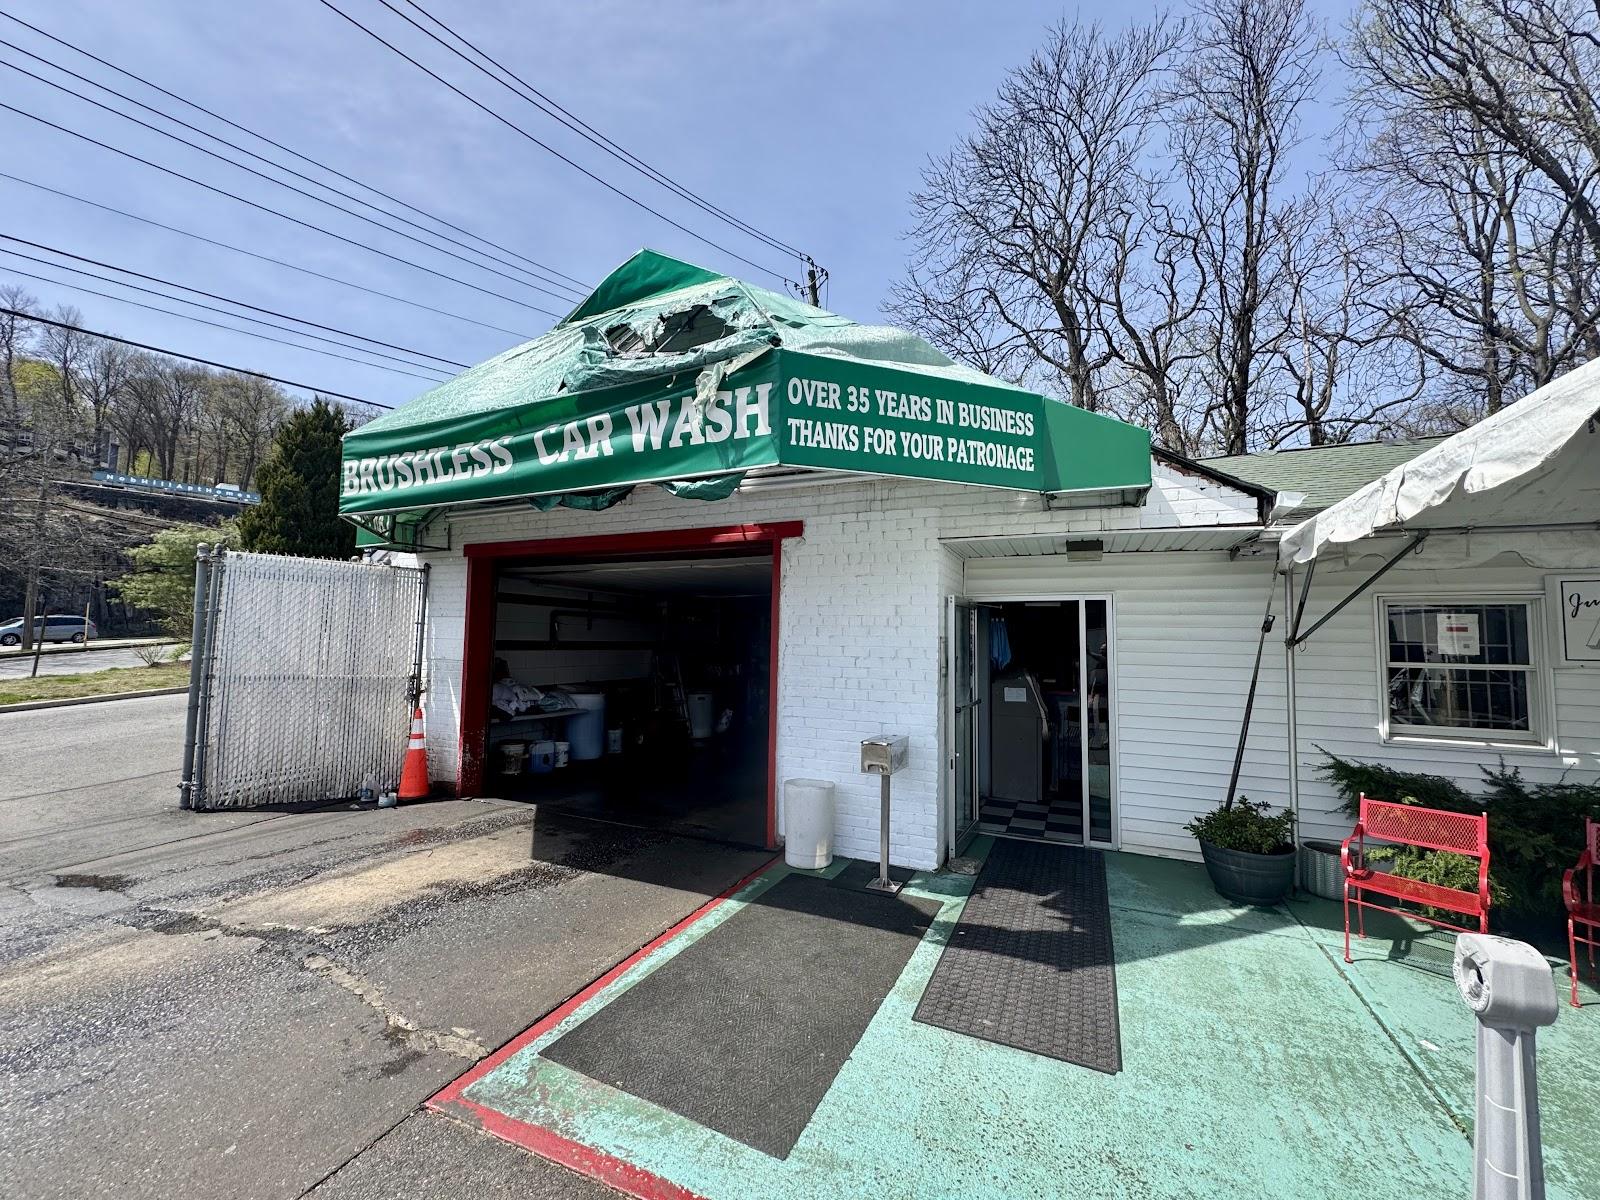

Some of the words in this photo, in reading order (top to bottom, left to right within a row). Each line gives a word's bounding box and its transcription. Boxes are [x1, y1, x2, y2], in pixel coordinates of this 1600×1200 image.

[787, 377, 842, 410] OVER
[847, 385, 870, 414] 35
[875, 389, 932, 422] YEARS
[936, 399, 954, 425] IN
[958, 403, 1035, 437] BUSINESS
[342, 434, 515, 498] BRUSHLESS
[533, 411, 614, 467] CAR
[624, 382, 774, 454] WASH
[787, 417, 859, 452] THANKS
[863, 426, 897, 456] FOR
[900, 431, 945, 461] YOUR
[947, 437, 1035, 472] PATRONAGE
